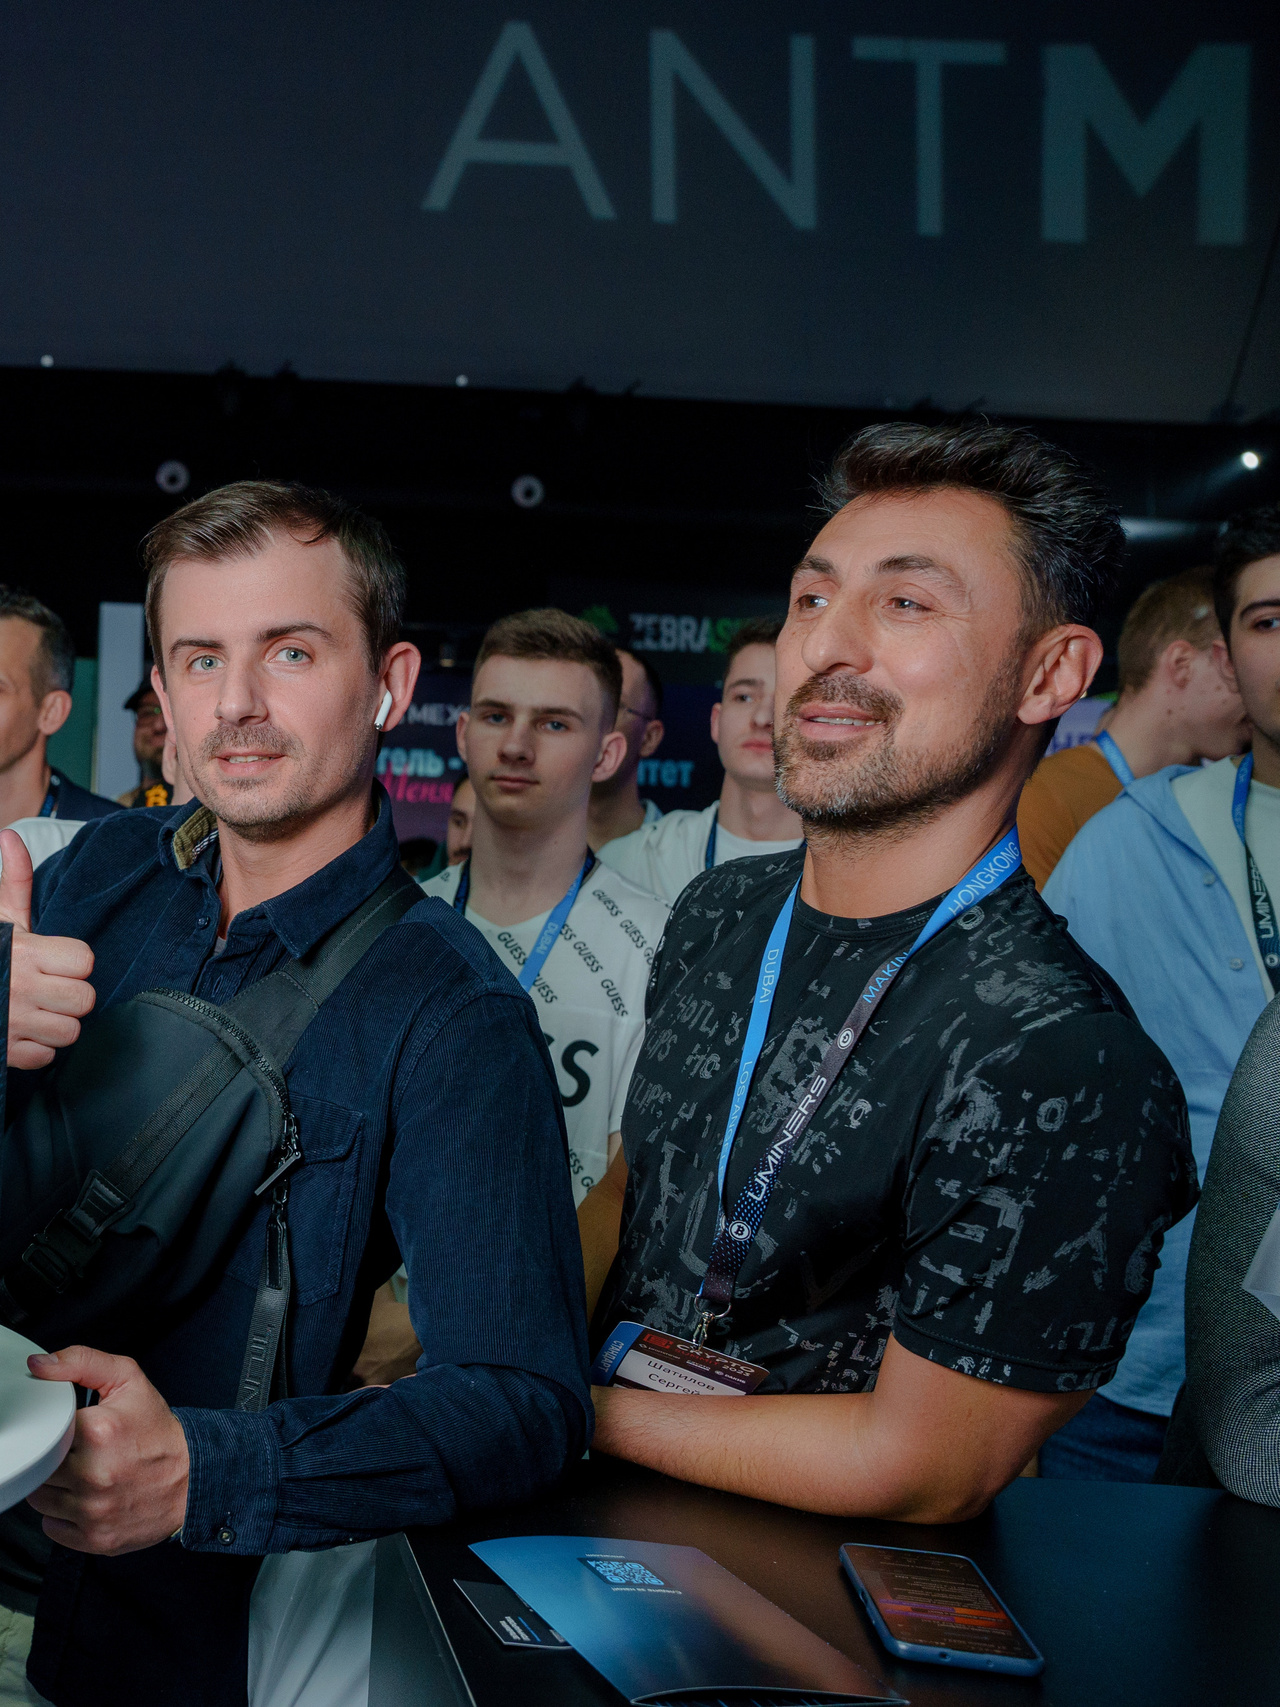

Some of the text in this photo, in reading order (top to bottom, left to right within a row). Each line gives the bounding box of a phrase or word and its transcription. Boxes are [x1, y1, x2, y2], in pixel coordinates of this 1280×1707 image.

[421, 21, 1252, 245] ANTM
[629, 612, 746, 652] ZEBRAS
[948, 841, 1020, 916] HONGKONG
[536, 922, 559, 956] DUBAI
[592, 889, 623, 918] GUESS
[619, 919, 648, 949] GUESS
[533, 973, 558, 1004] UESS
[559, 923, 629, 1017] ESS GUESS GUESS
[759, 949, 779, 1003] DUBAI
[747, 1074, 828, 1202] UMINERS
[598, 1340, 625, 1373] СТАНДАРТ
[647, 1360, 716, 1391] Шатилов
[722, 1365, 751, 1378] 2023
